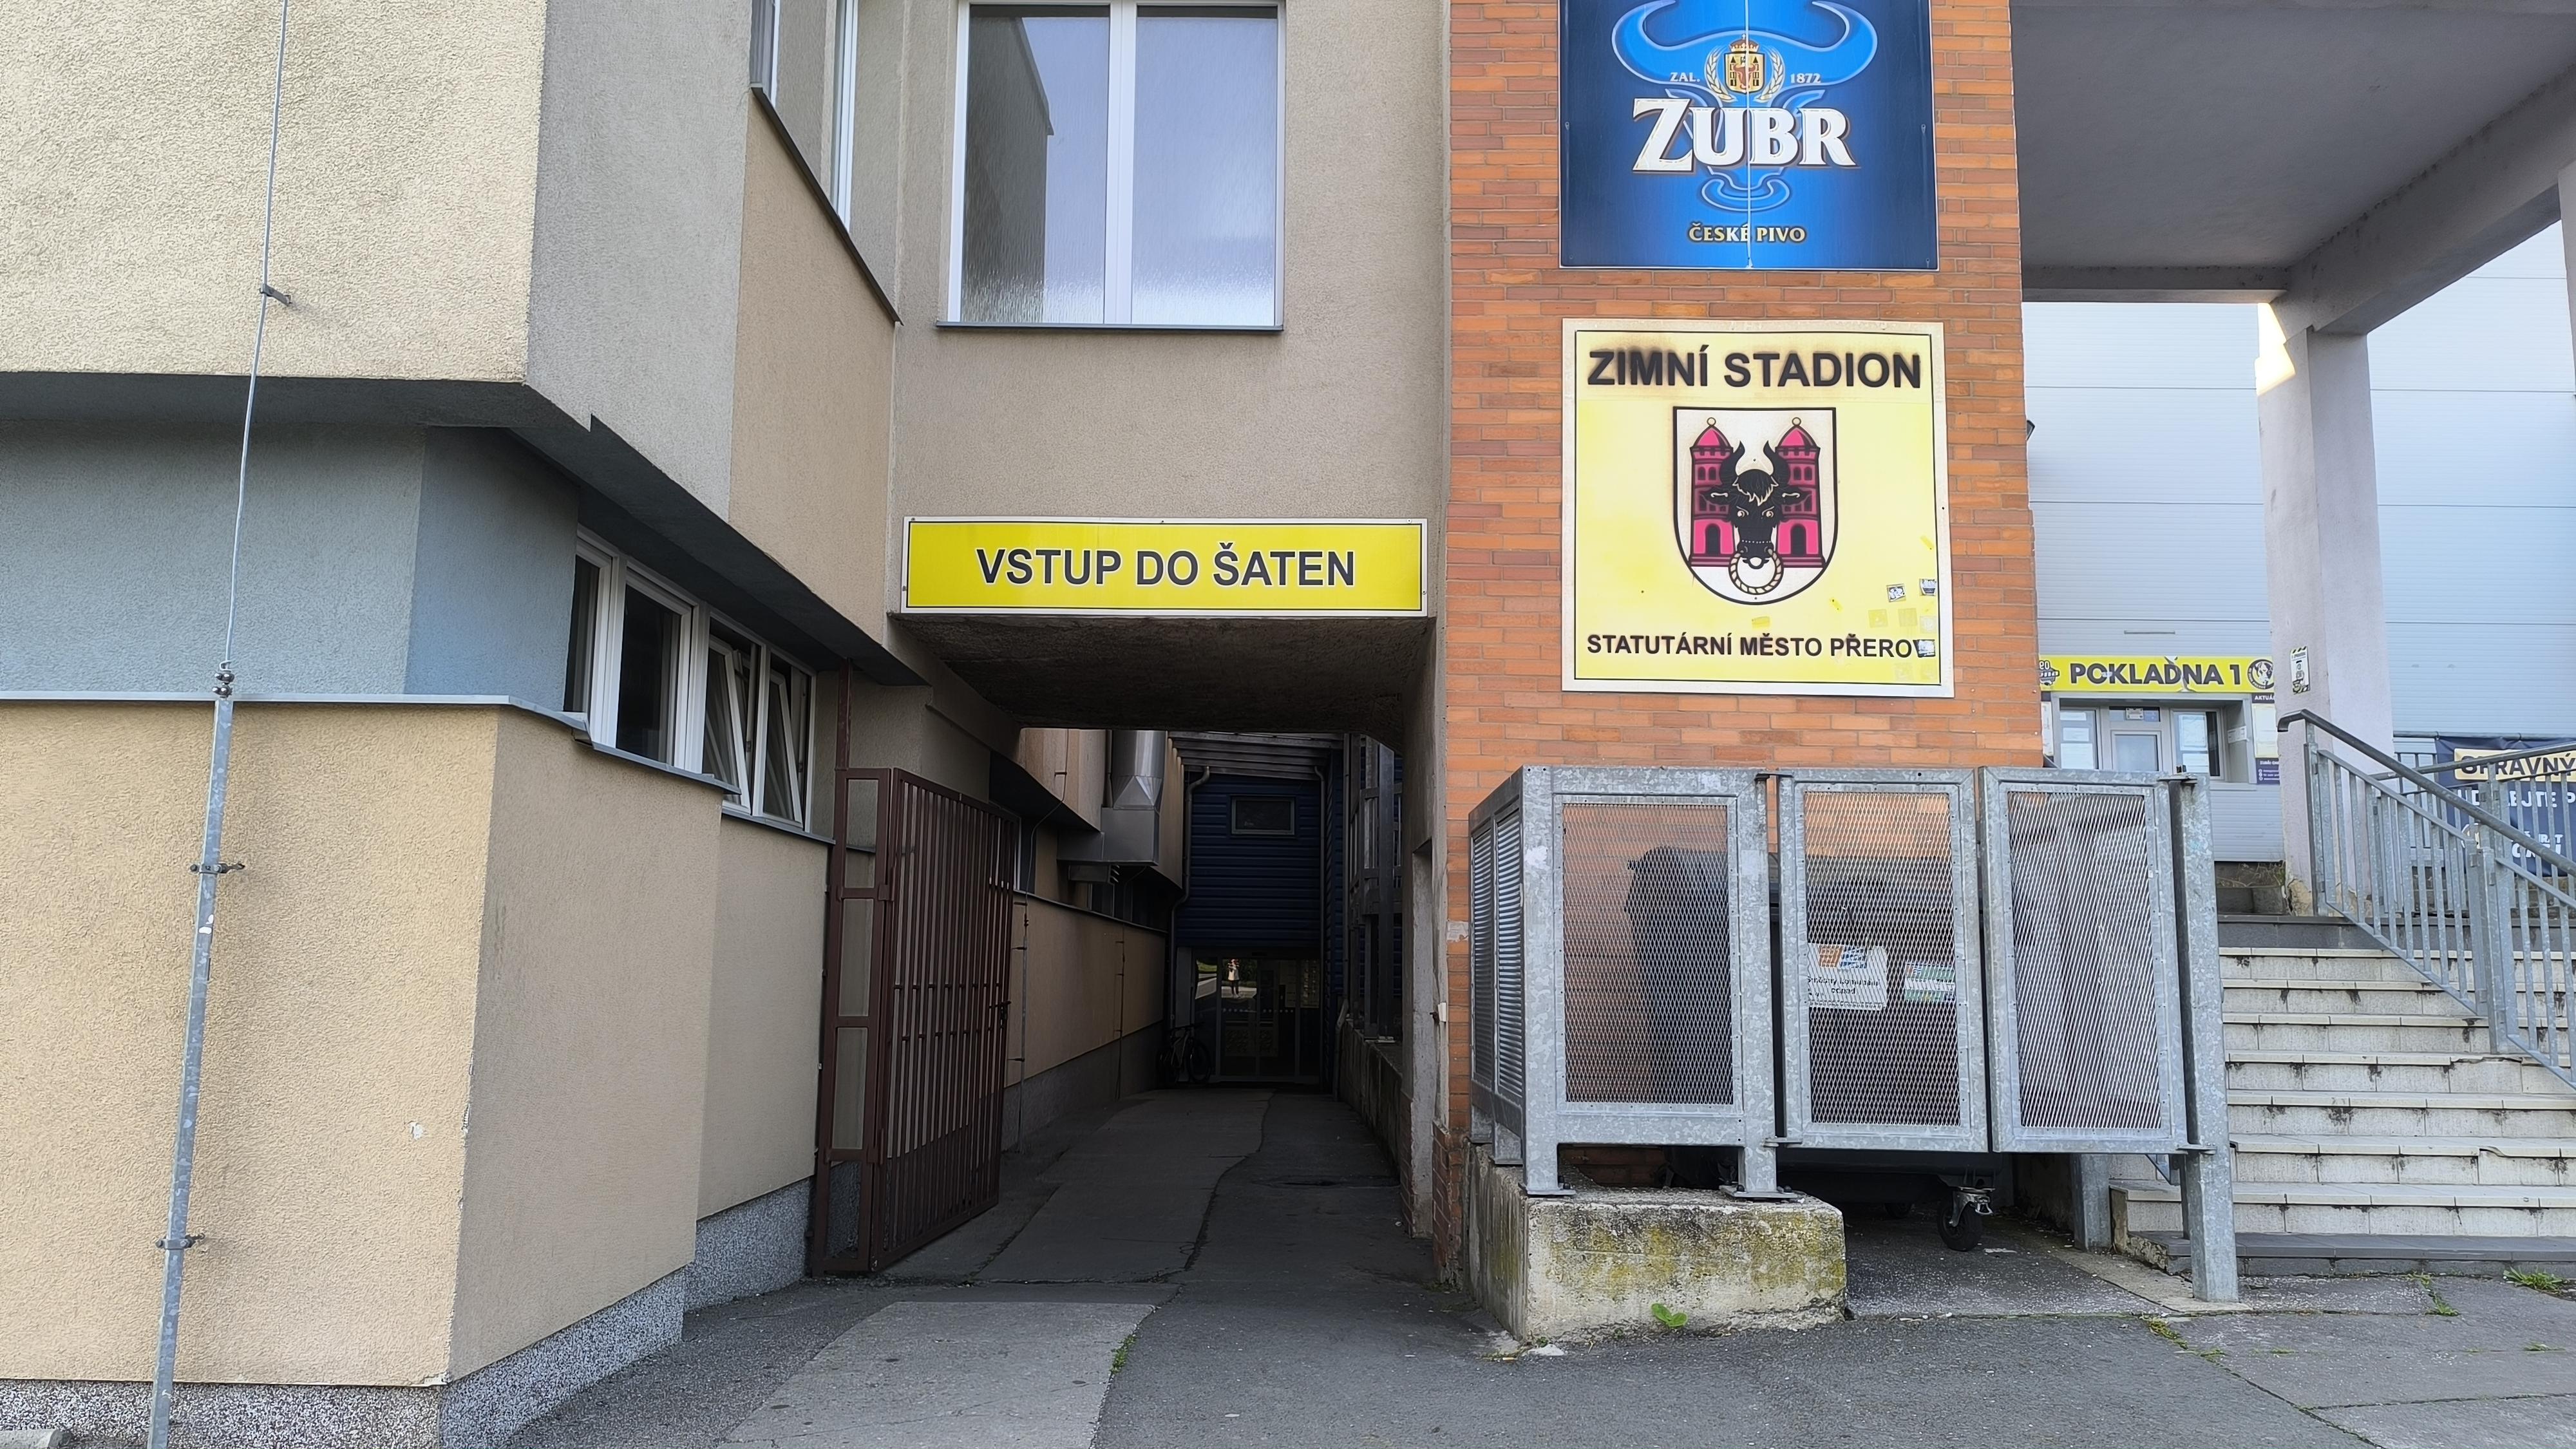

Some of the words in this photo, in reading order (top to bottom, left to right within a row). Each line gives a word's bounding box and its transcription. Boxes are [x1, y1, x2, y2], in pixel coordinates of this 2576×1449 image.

[1669, 72, 1700, 82] ZAL.
[1790, 73, 1821, 83] 1872
[1633, 97, 1857, 172] ZUBR
[1688, 222, 1750, 242] ČESKÉ
[1756, 227, 1807, 242] PIVO
[1587, 344, 1710, 386] ZIMNÍ
[1723, 351, 1922, 389] STADION
[976, 548, 1122, 585] VSTUP
[1137, 550, 1199, 586] DO
[1213, 542, 1355, 587] ŠATEN
[1587, 632, 1732, 656] STATUTÁRNÍ
[1739, 632, 1823, 657] MĚSTO
[2070, 663, 2224, 685] POKLADNA
[2229, 664, 2240, 685] 1
